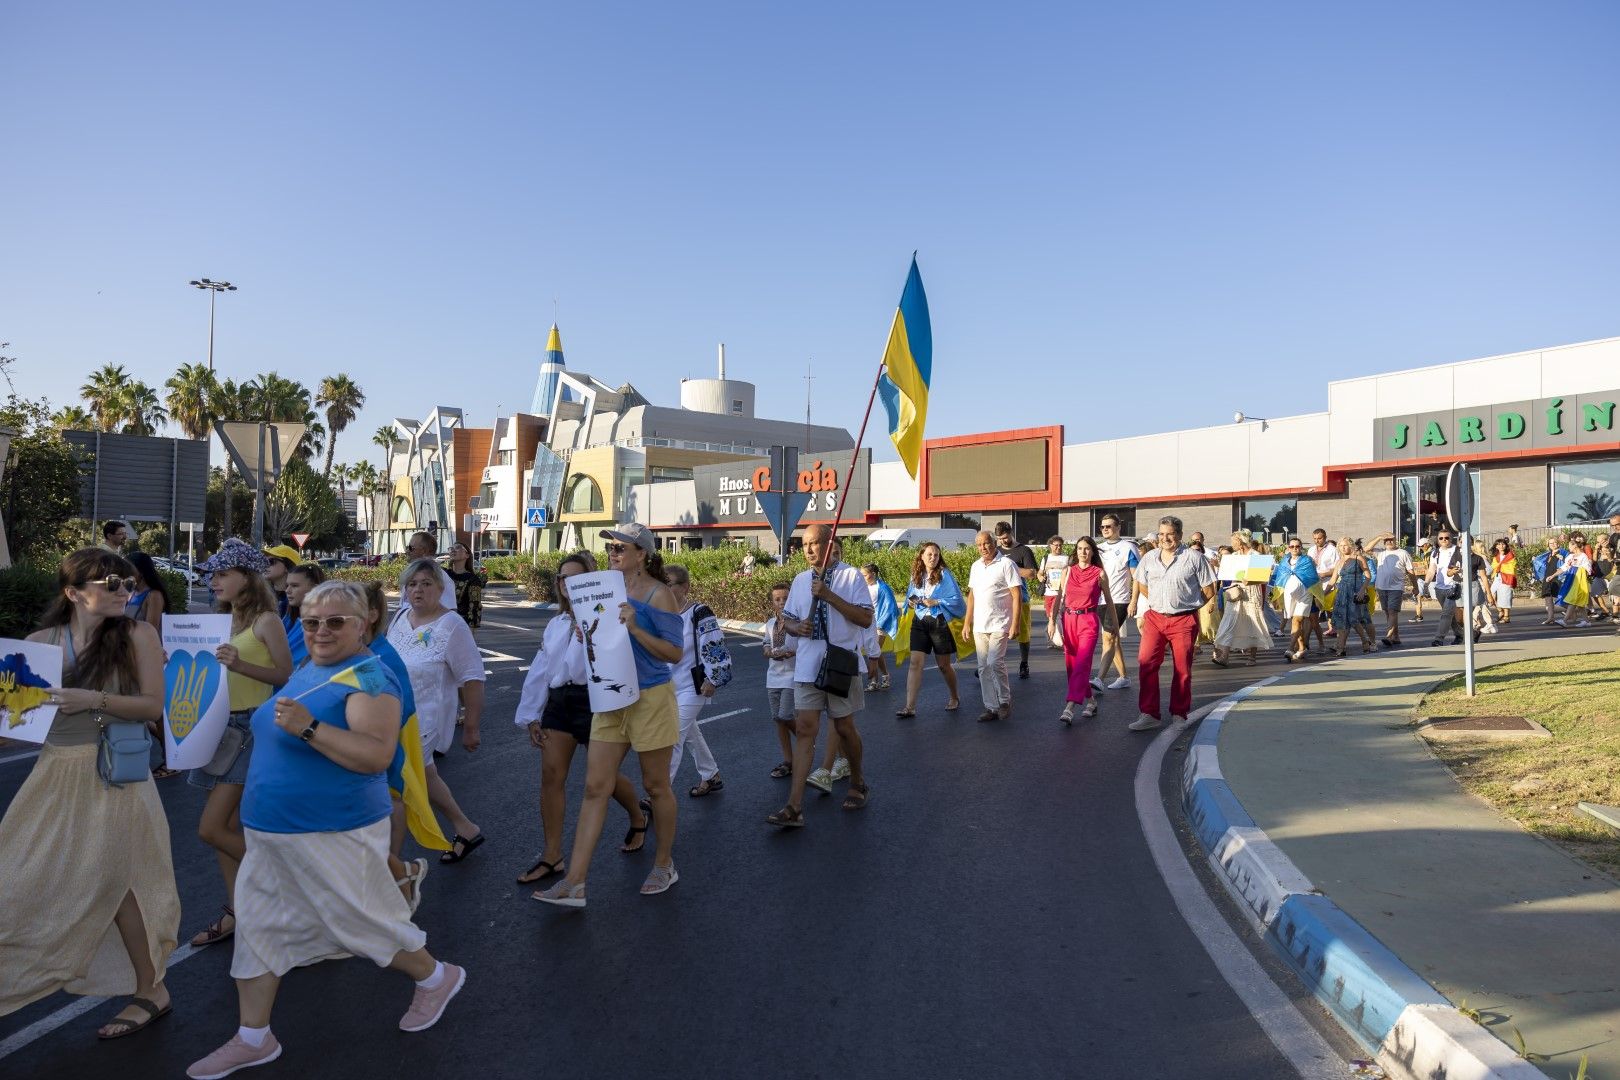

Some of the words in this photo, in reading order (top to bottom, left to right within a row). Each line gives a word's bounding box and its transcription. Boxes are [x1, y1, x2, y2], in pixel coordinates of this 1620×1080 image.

[1391, 398, 1616, 449] JARDÍN
[720, 477, 752, 491] Hnos.
[752, 461, 838, 492] Gcía
[720, 492, 837, 515] MUEES
[591, 591, 614, 601] freedom!
